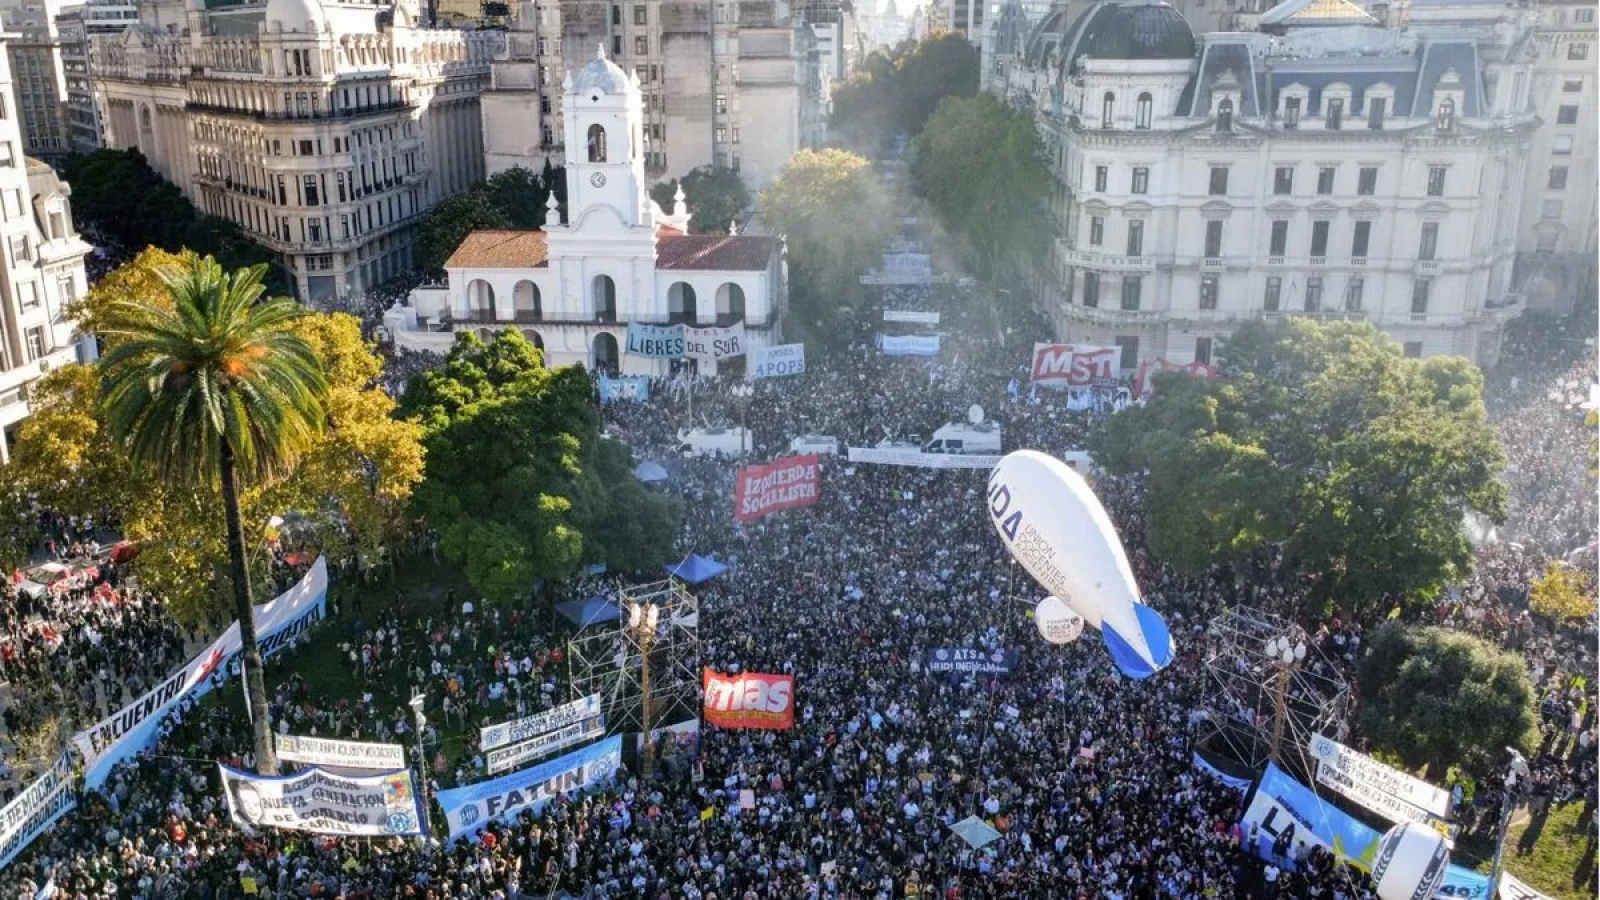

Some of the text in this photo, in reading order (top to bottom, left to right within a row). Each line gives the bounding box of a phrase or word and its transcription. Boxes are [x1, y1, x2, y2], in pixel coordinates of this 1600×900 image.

[630, 332, 740, 357] LIBRES DEL SUR
[756, 358, 804, 376] APOPS
[743, 464, 815, 496] IZQUIERDA
[741, 481, 816, 515] SOCIALISTA
[1019, 532, 1067, 585] DOCENTES
[954, 648, 985, 660] ATSA
[90, 671, 187, 752] ENCUENTRO
[705, 677, 791, 713] mas
[262, 794, 308, 808] NUEVA
[486, 766, 585, 817] FATUN
[1260, 805, 1296, 850] LA
